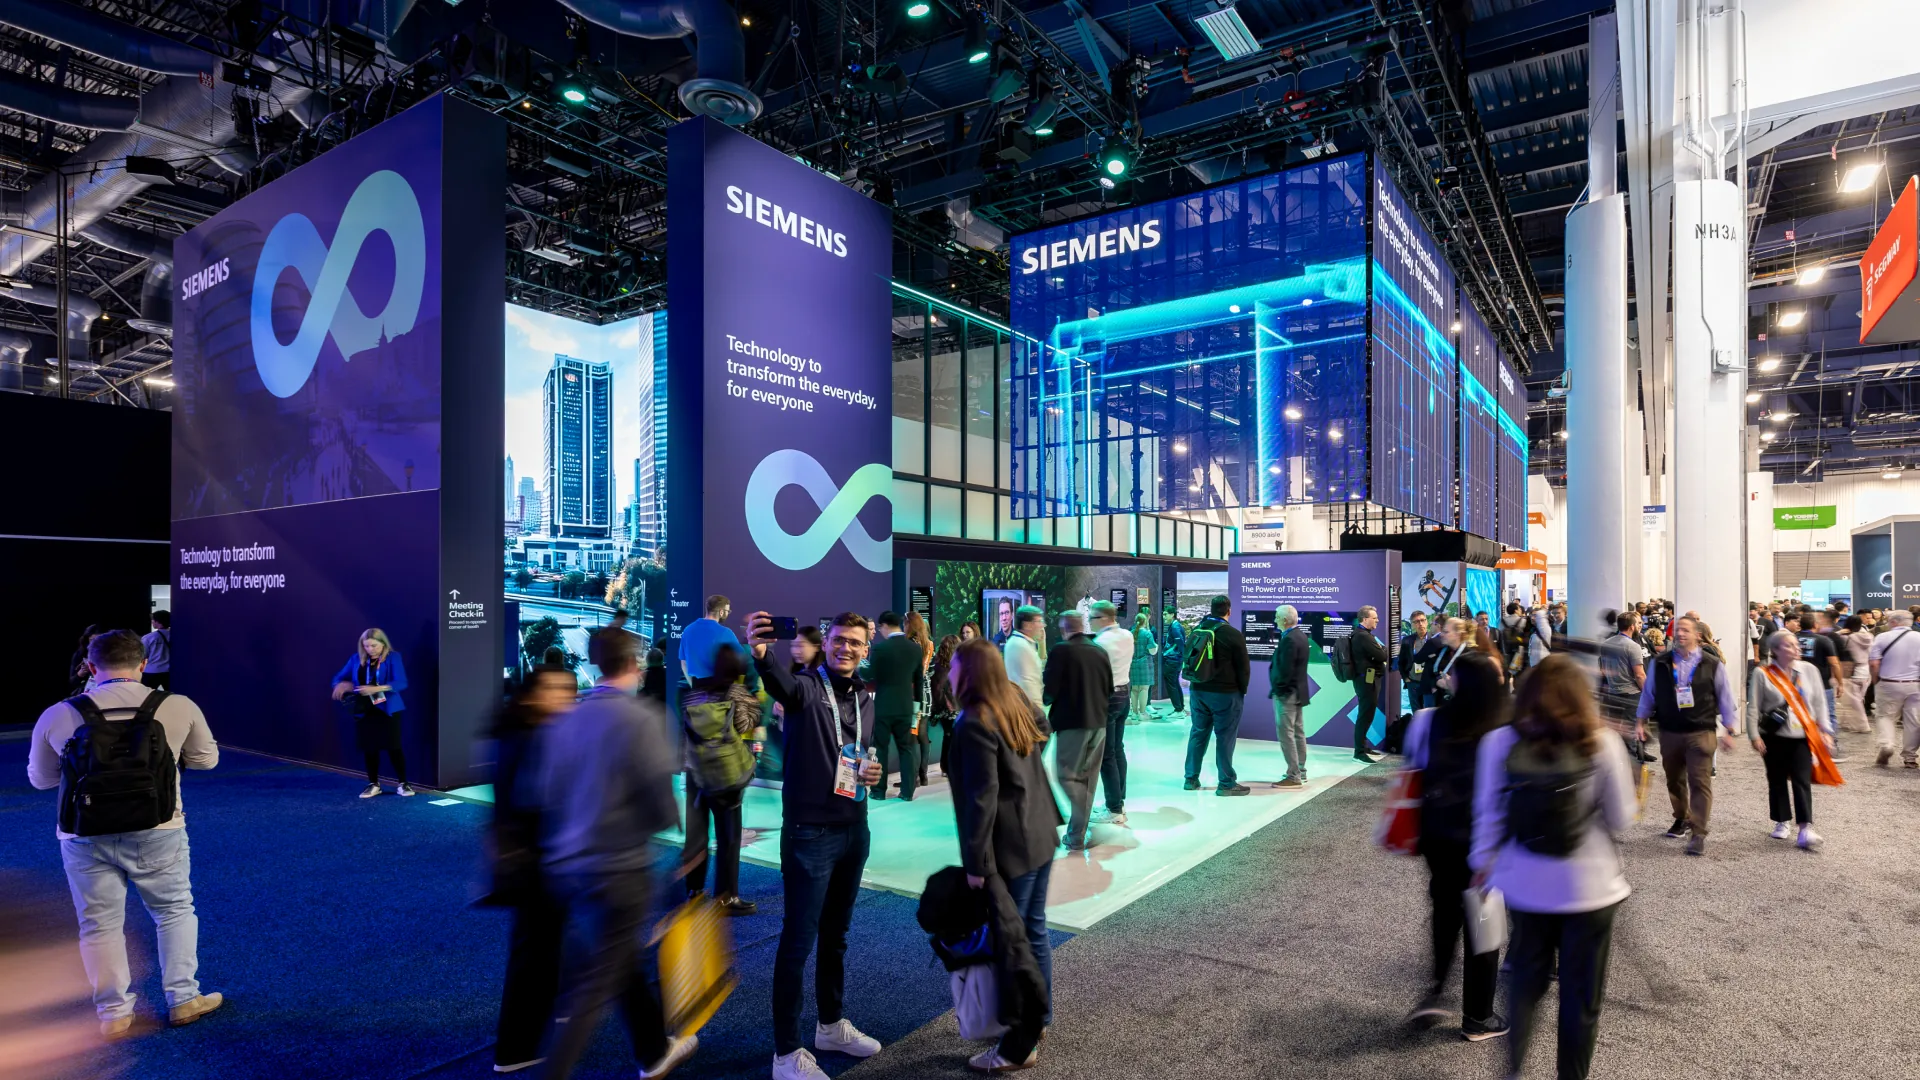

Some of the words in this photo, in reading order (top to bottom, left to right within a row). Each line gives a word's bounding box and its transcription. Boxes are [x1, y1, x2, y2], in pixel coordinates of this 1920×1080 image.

[726, 185, 848, 258] SIEMENS
[1378, 179, 1410, 245] Technology
[1410, 230, 1416, 250] to
[1378, 211, 1389, 239] the
[1695, 223, 1737, 242] NH3A
[1022, 219, 1161, 275] SIEMENS
[1874, 235, 1901, 285] SEGWAY
[182, 257, 230, 301] SIEMENS
[726, 334, 806, 373] Technology
[808, 358, 822, 373] to
[726, 358, 796, 388] transform
[798, 376, 820, 393] the
[822, 384, 877, 410] everyday,
[726, 380, 748, 398] for
[751, 388, 814, 413] everyone
[180, 546, 221, 568] Technology
[223, 547, 232, 562] to
[232, 542, 275, 561] transform
[180, 572, 193, 590] the
[193, 572, 229, 594] everyday,
[230, 571, 243, 589] for
[243, 573, 286, 594] everyone
[1262, 577, 1296, 586] Together:
[1296, 576, 1337, 585] Experience
[1277, 585, 1285, 593] of
[1286, 585, 1300, 593] The
[1301, 585, 1340, 595] Ecosystem
[449, 602, 484, 611] Meeting
[449, 610, 484, 618] Check-in
[670, 631, 684, 639] Chec
